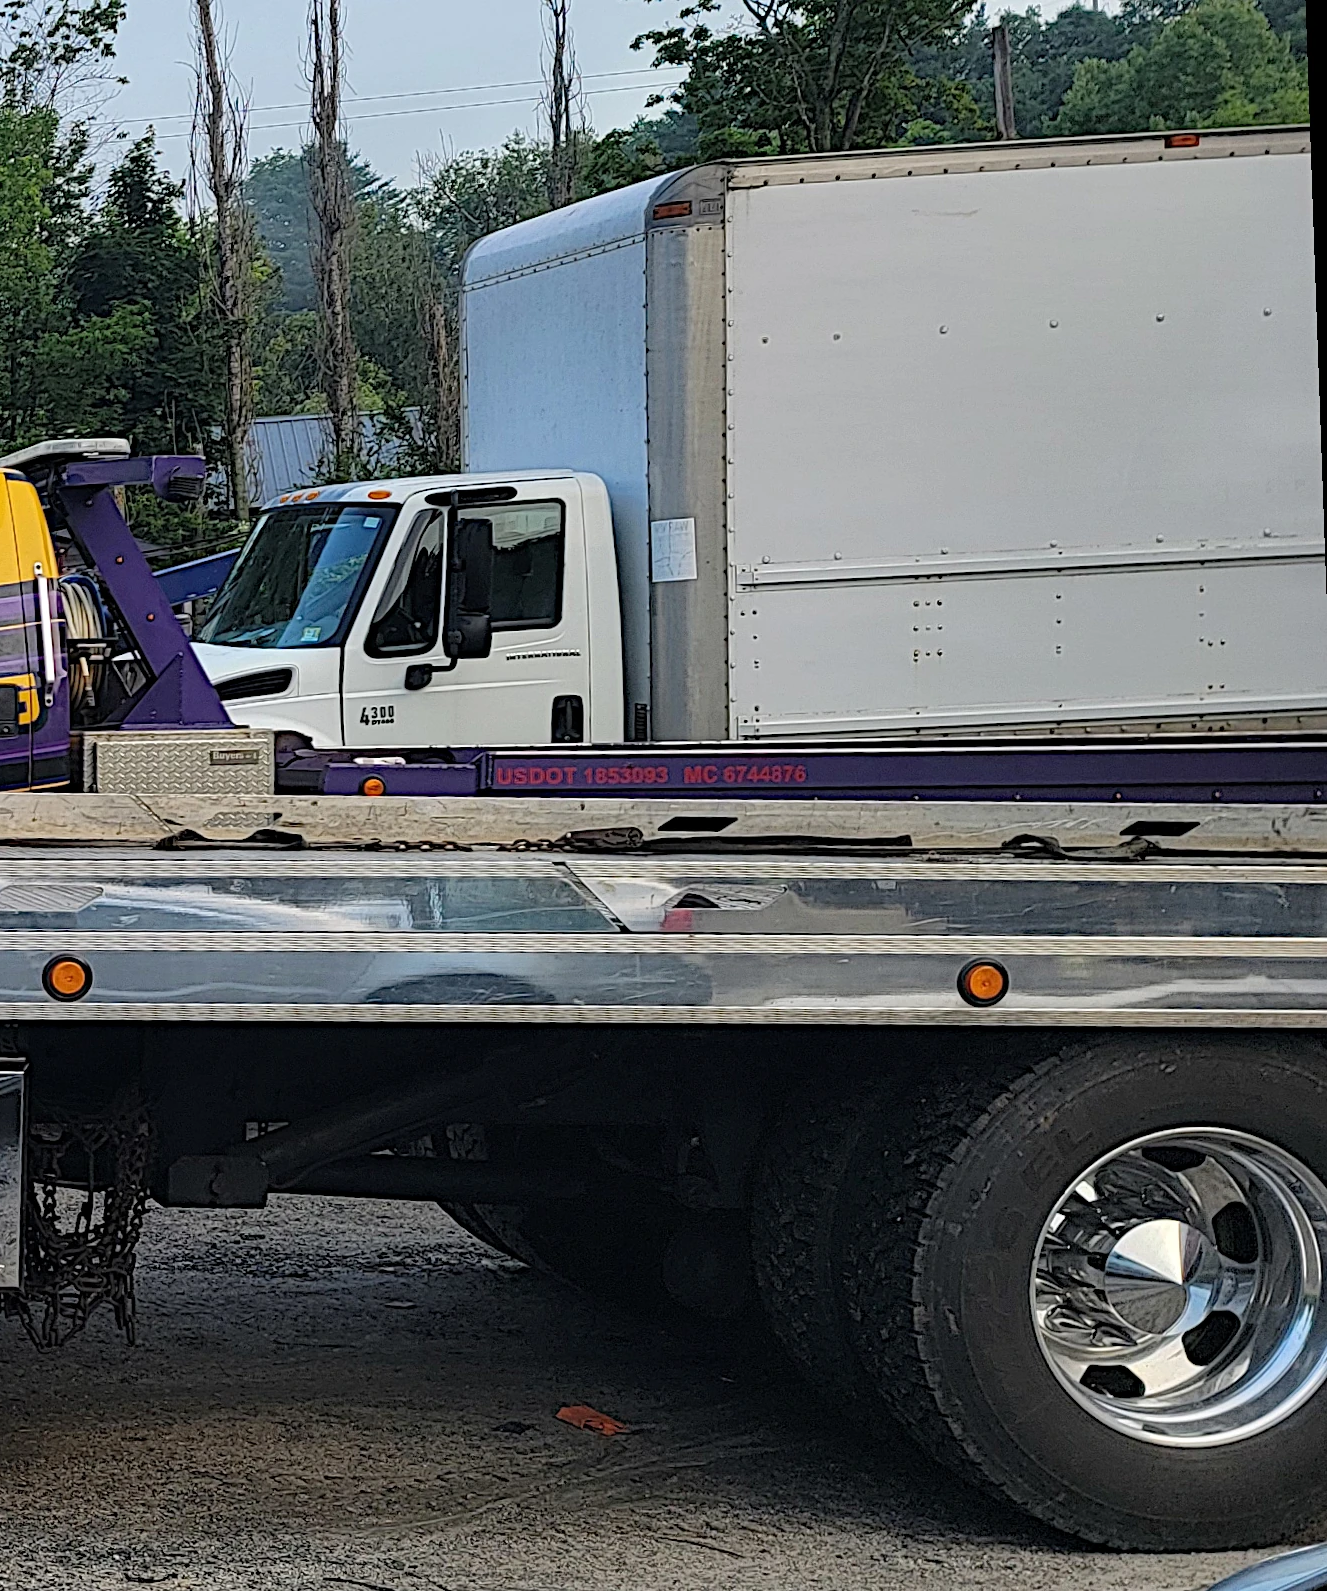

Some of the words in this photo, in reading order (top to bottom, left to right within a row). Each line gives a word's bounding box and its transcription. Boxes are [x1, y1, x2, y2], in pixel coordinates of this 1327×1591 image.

[497, 766, 577, 785] USDOT
[584, 766, 668, 784] 1853093
[683, 765, 718, 783] MC
[722, 764, 807, 783] 6744876
